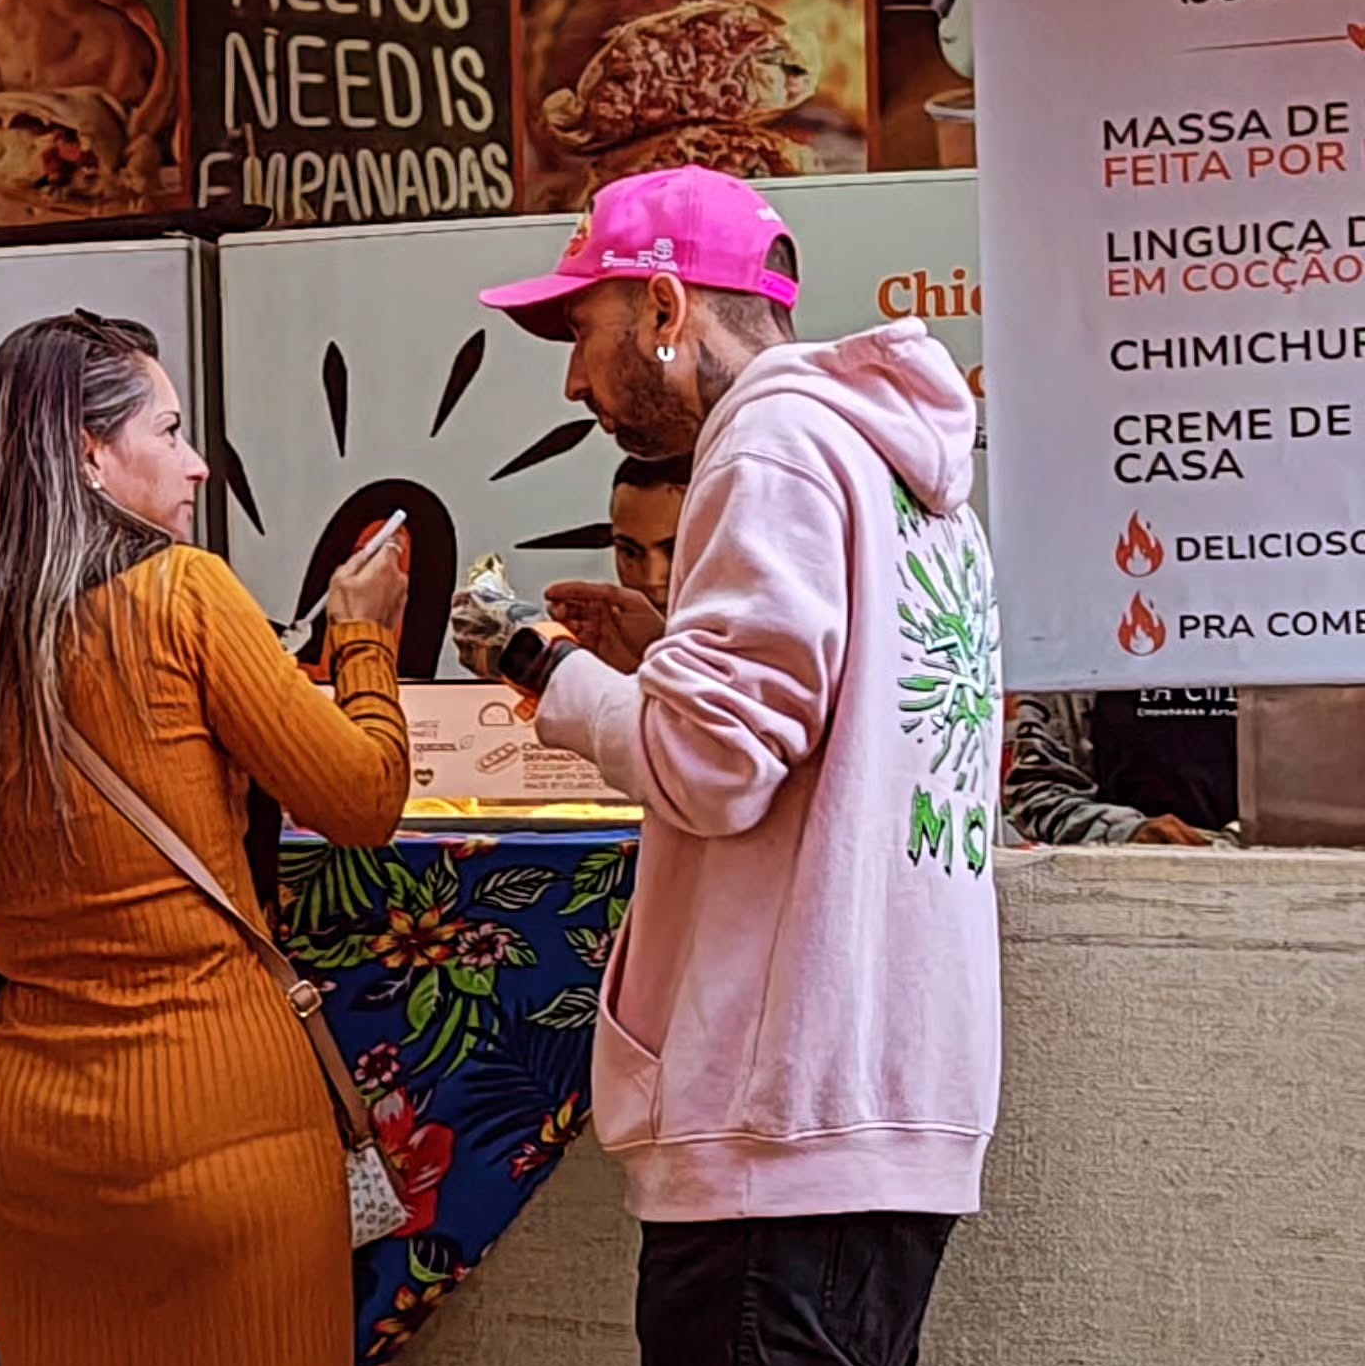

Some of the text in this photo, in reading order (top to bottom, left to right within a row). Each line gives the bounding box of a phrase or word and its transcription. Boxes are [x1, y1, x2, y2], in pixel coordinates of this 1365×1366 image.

[224, 28, 495, 134] NEED IS
[1101, 101, 1350, 151] MASSA DE
[1103, 140, 1347, 188] FEITA POR
[1106, 217, 1332, 265] LINGUIÇA
[1108, 246, 1364, 298] EM COCÇÃO
[1112, 403, 1353, 448] CREME DE
[1113, 448, 1246, 484] CASA
[1179, 613, 1255, 641] PRA
